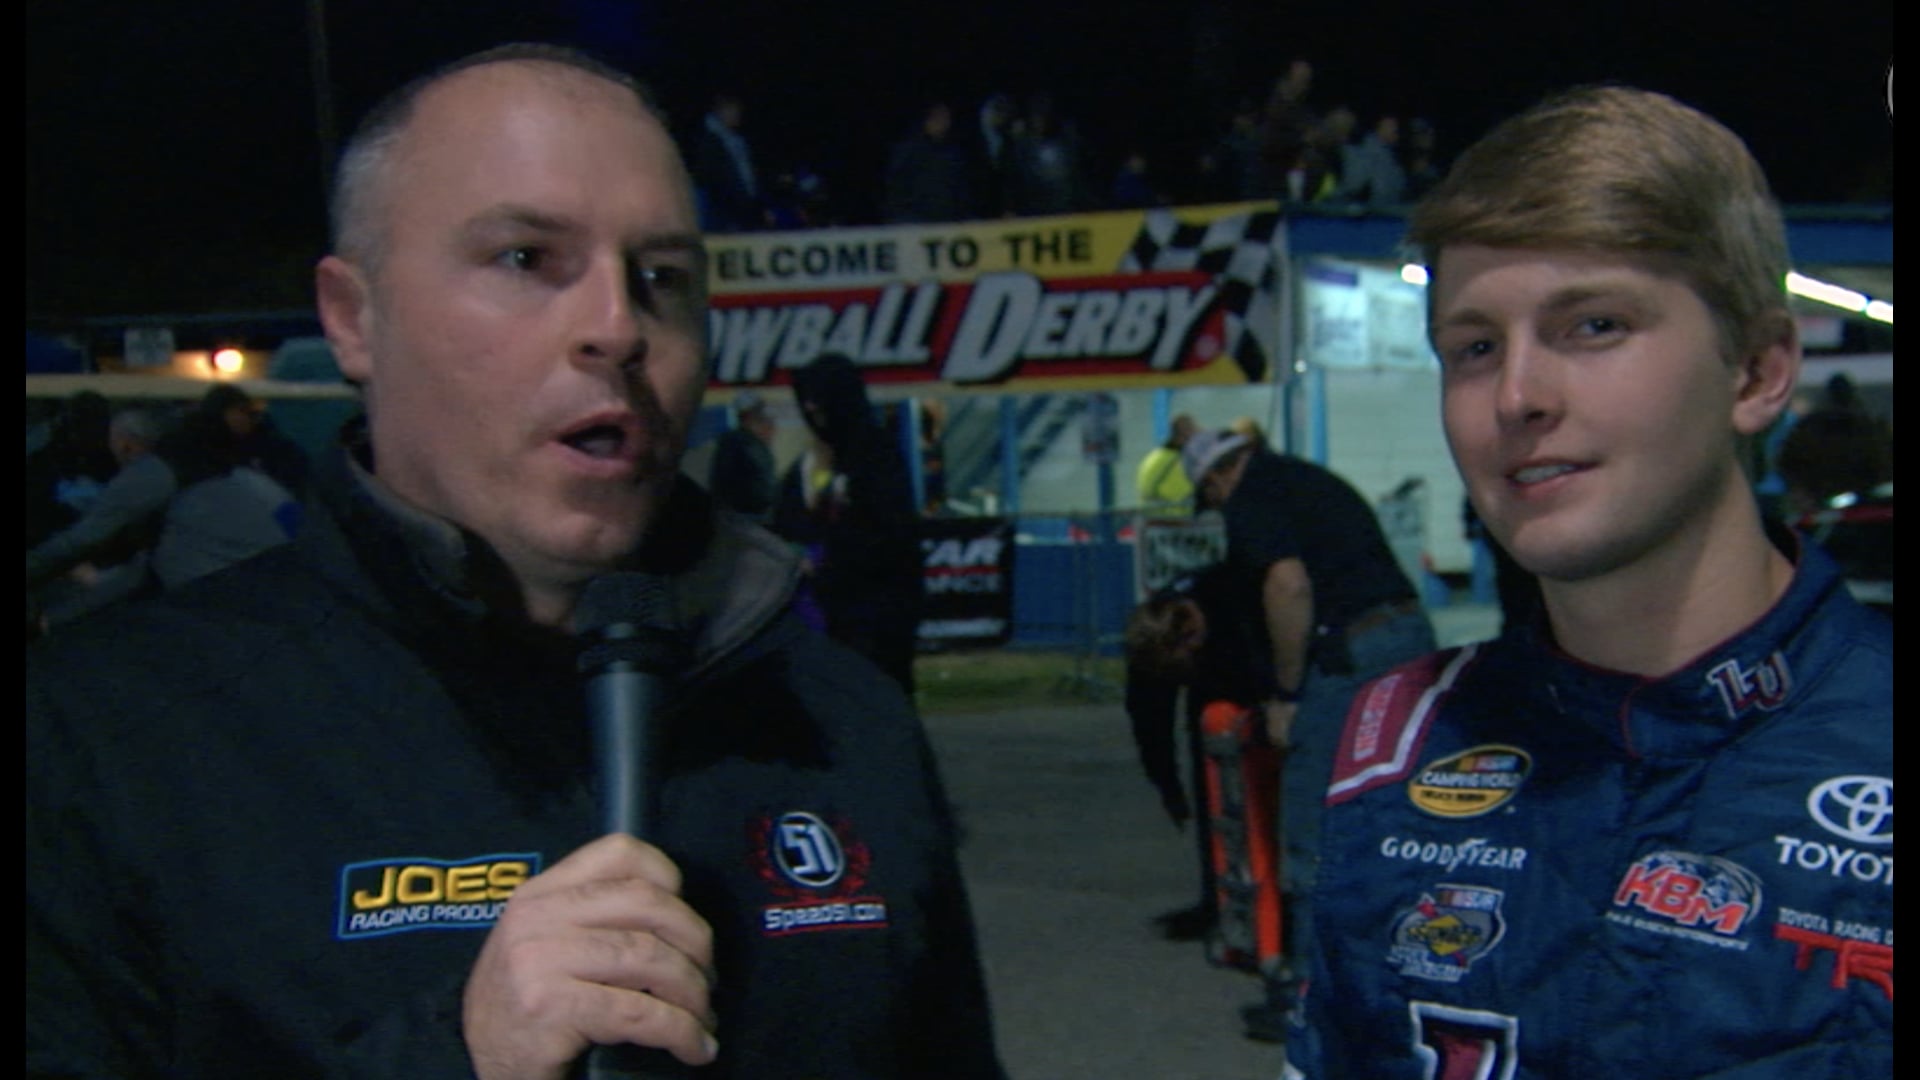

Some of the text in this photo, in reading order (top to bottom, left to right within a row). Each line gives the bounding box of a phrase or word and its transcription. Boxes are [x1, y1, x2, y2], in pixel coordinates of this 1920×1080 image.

[713, 228, 1092, 280] ELCOME TO THE
[940, 271, 1219, 380] DERBY
[921, 538, 1003, 567] AR
[780, 823, 836, 875] 51
[1380, 836, 1529, 873] GOODYEAR
[353, 861, 530, 910] JOES
[1613, 862, 1750, 935] KBM
[350, 904, 430, 931] RACING
[1778, 906, 1829, 933] TOYOTA
[1833, 920, 1881, 943] RACING
